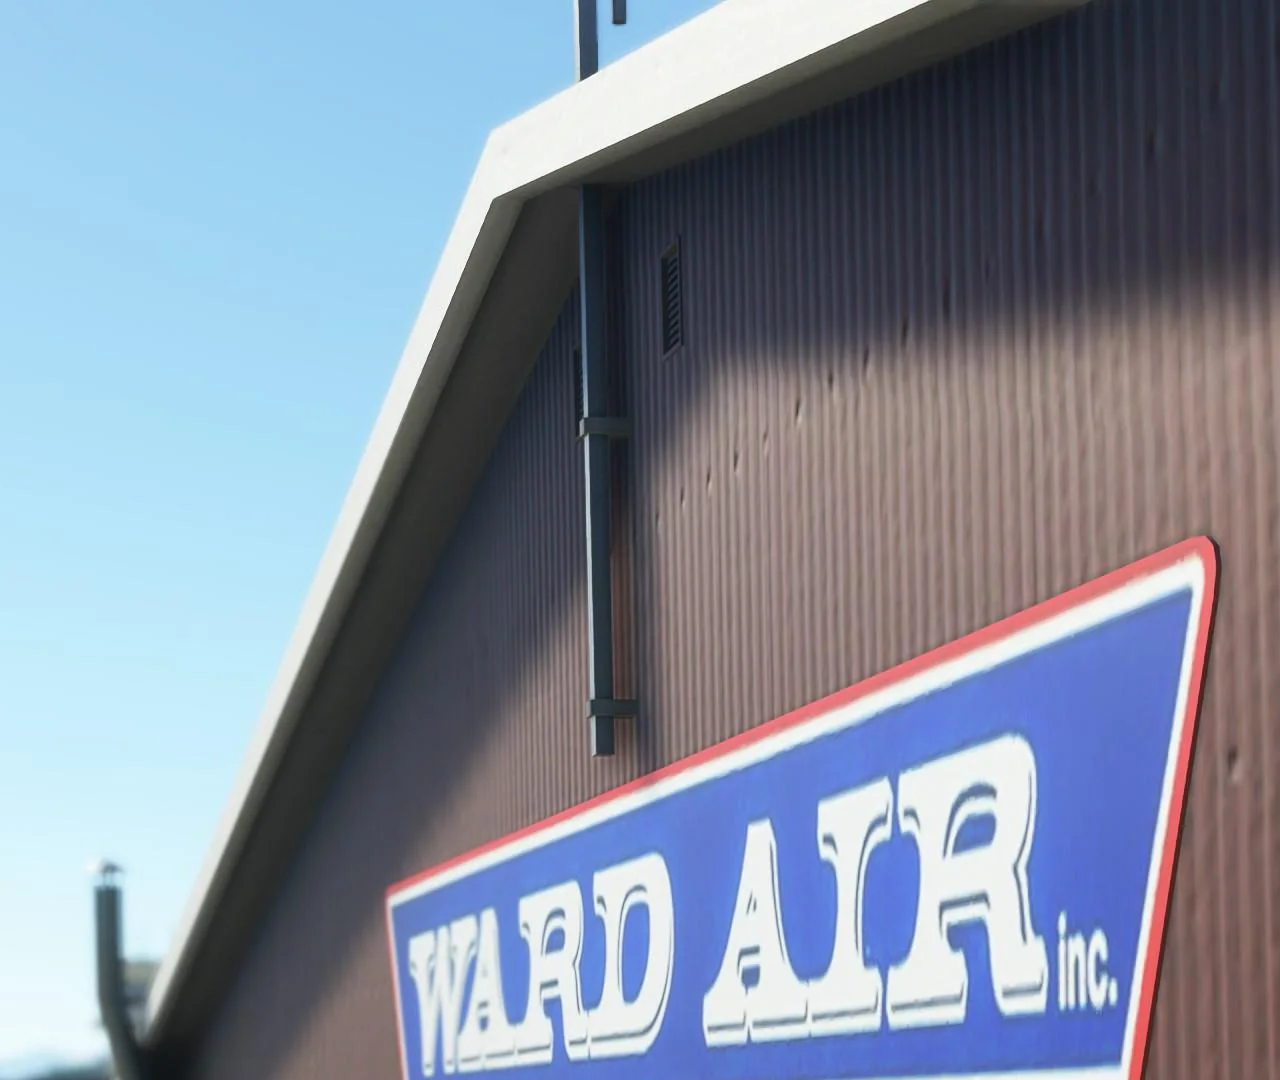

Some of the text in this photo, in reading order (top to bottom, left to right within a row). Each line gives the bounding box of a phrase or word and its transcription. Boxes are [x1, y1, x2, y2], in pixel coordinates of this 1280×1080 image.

[408, 732, 1118, 1078] WARD AIR inc.
